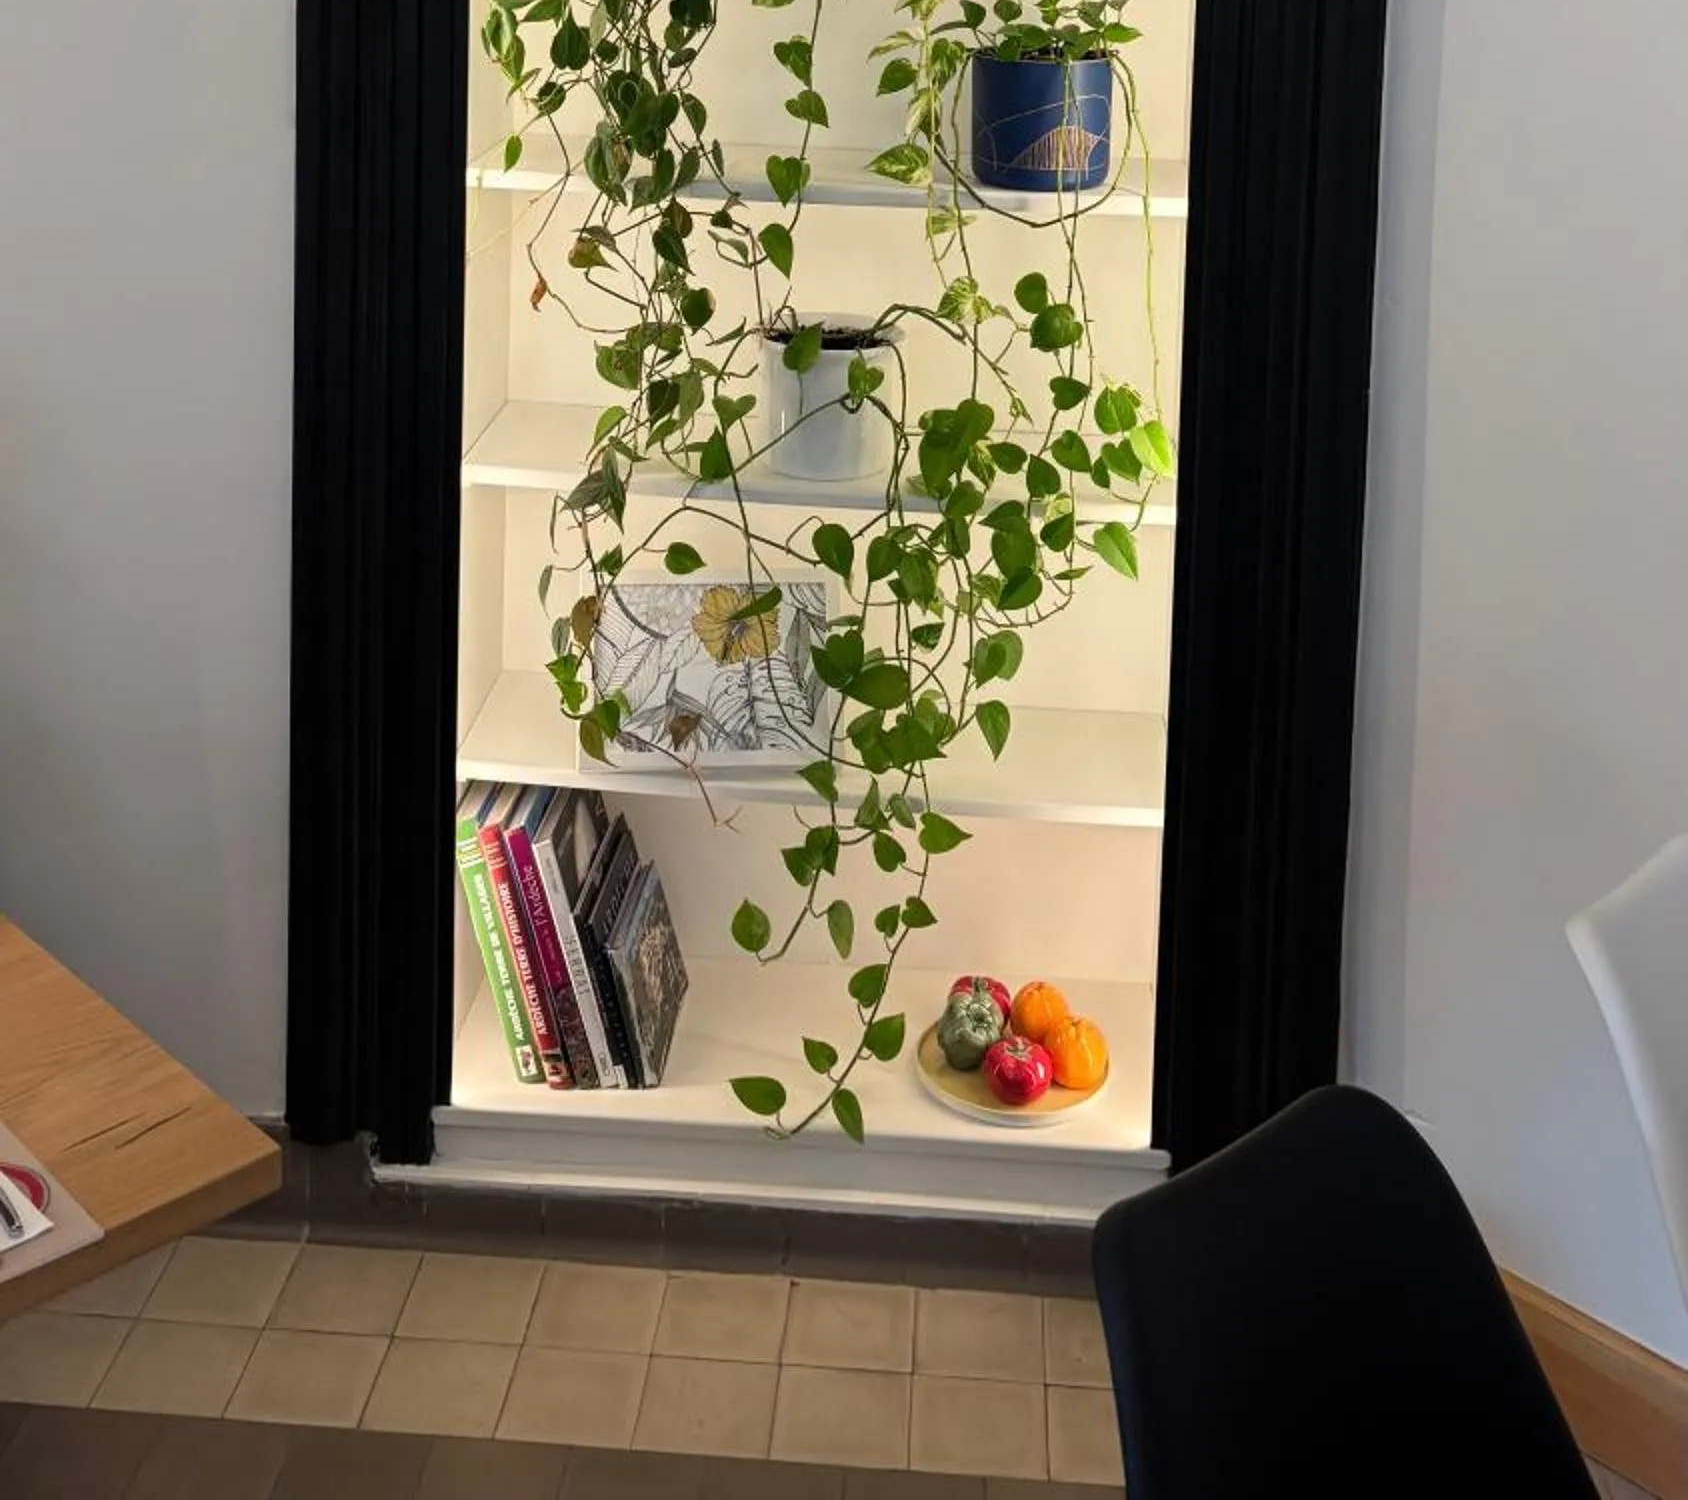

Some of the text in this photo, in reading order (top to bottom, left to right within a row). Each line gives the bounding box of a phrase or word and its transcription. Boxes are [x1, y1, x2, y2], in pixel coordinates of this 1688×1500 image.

[474, 873, 494, 930] VILLAGES
[498, 882, 524, 948] D'HISTOIRE
[494, 949, 511, 987] TERRE
[515, 947, 532, 984] TERRE
